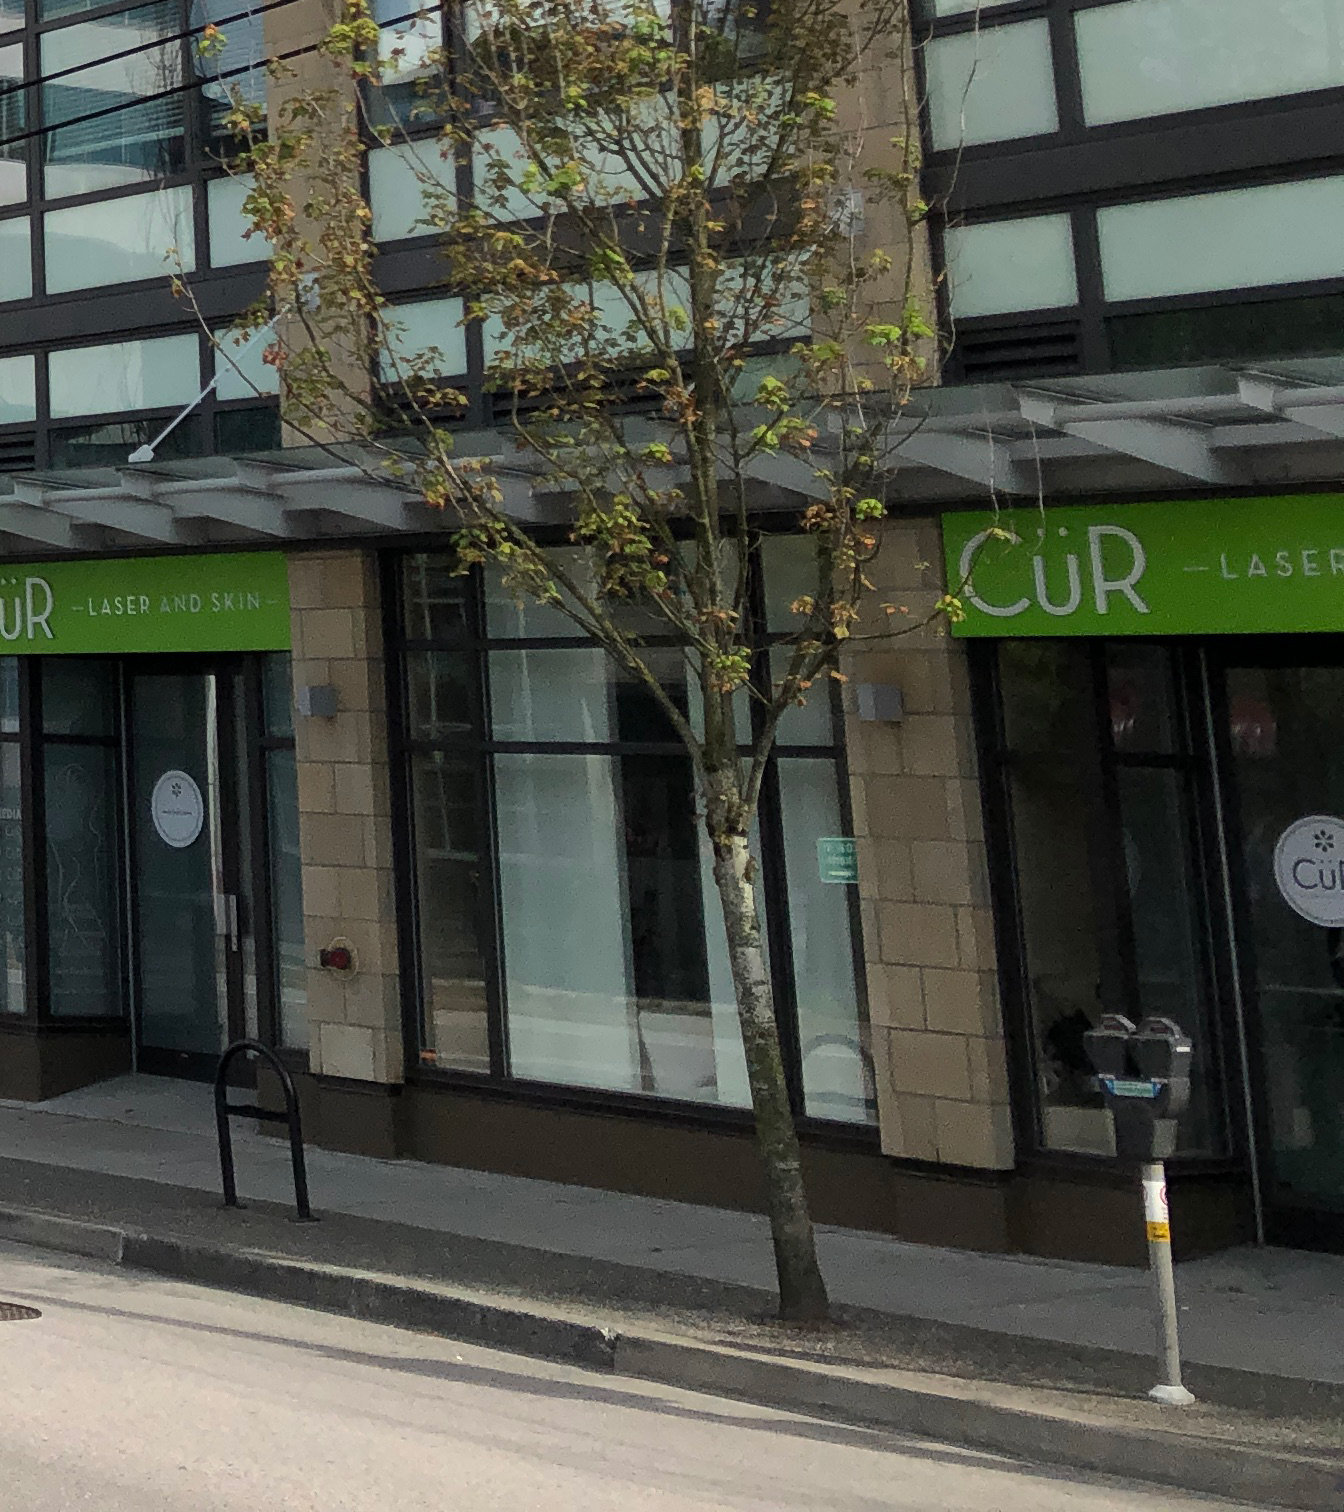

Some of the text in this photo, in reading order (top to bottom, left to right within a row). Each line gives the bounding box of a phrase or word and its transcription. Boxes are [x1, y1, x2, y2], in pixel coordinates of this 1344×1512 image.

[1220, 548, 1344, 580] LASER
[88, 595, 150, 616] LASER
[160, 593, 201, 614] AND
[212, 592, 260, 611] SKIN
[1293, 858, 1344, 890] Cü
